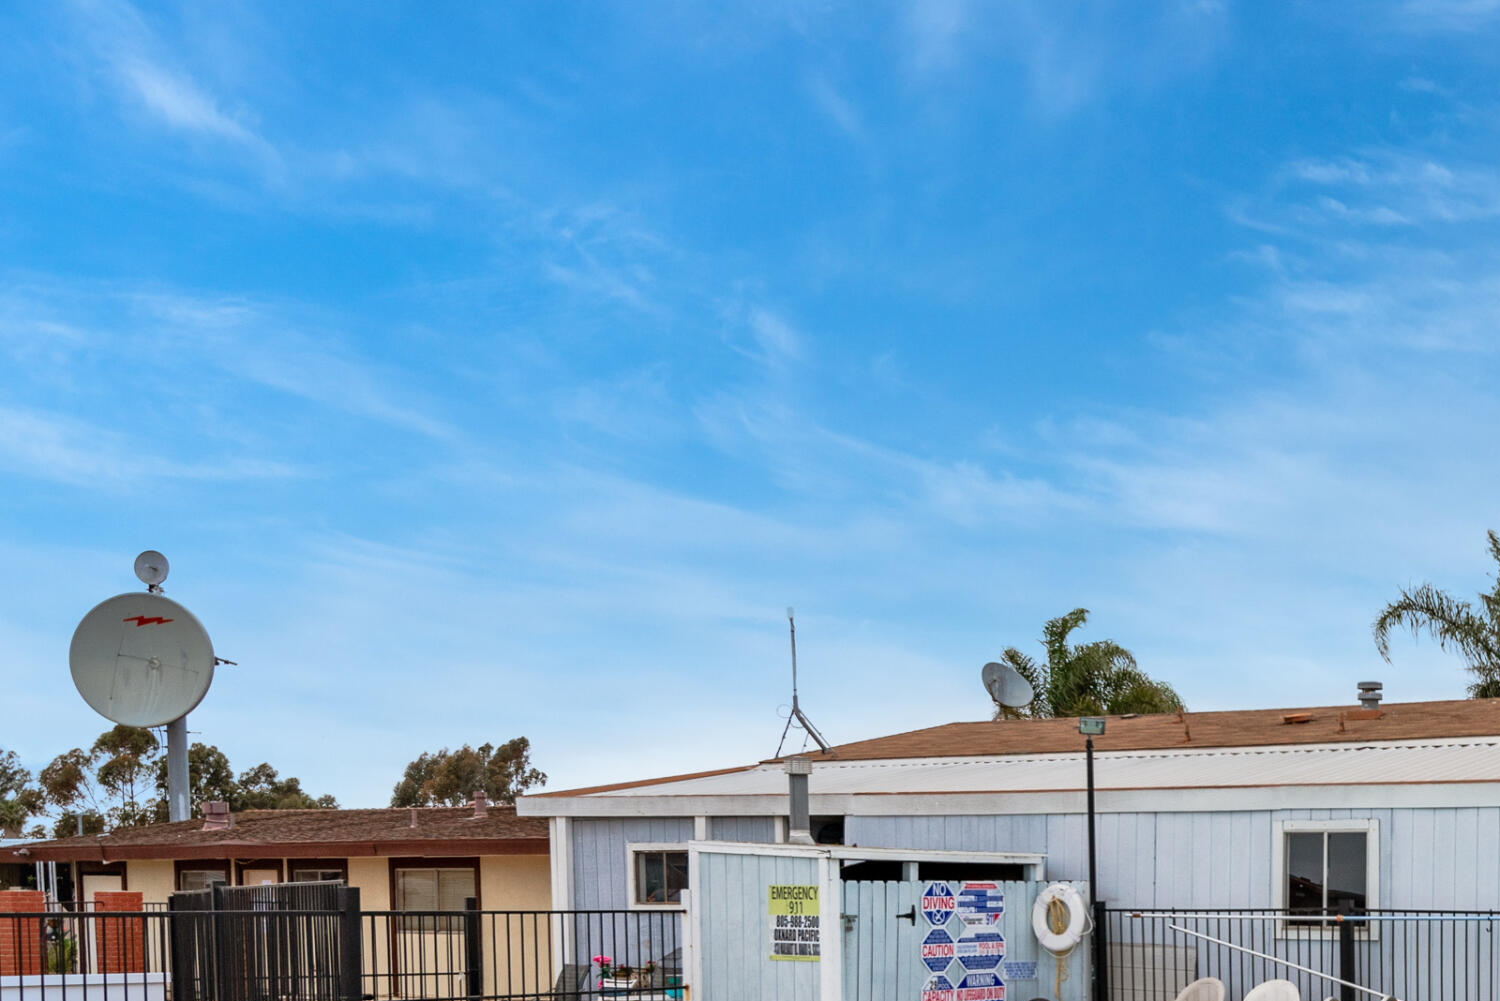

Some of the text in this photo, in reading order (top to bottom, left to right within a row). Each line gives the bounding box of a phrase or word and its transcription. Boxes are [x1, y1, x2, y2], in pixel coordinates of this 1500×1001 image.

[771, 886, 819, 900] EMERGENCY
[933, 883, 946, 896] NO
[789, 900, 804, 914] 911
[923, 897, 955, 910] DIVING
[774, 928, 820, 942] OXNARD PACIFIC
[922, 944, 954, 957] CAUTION
[966, 974, 995, 986] WARNING
[956, 987, 1005, 1001] NO LIFEGUARD ON DUTY
